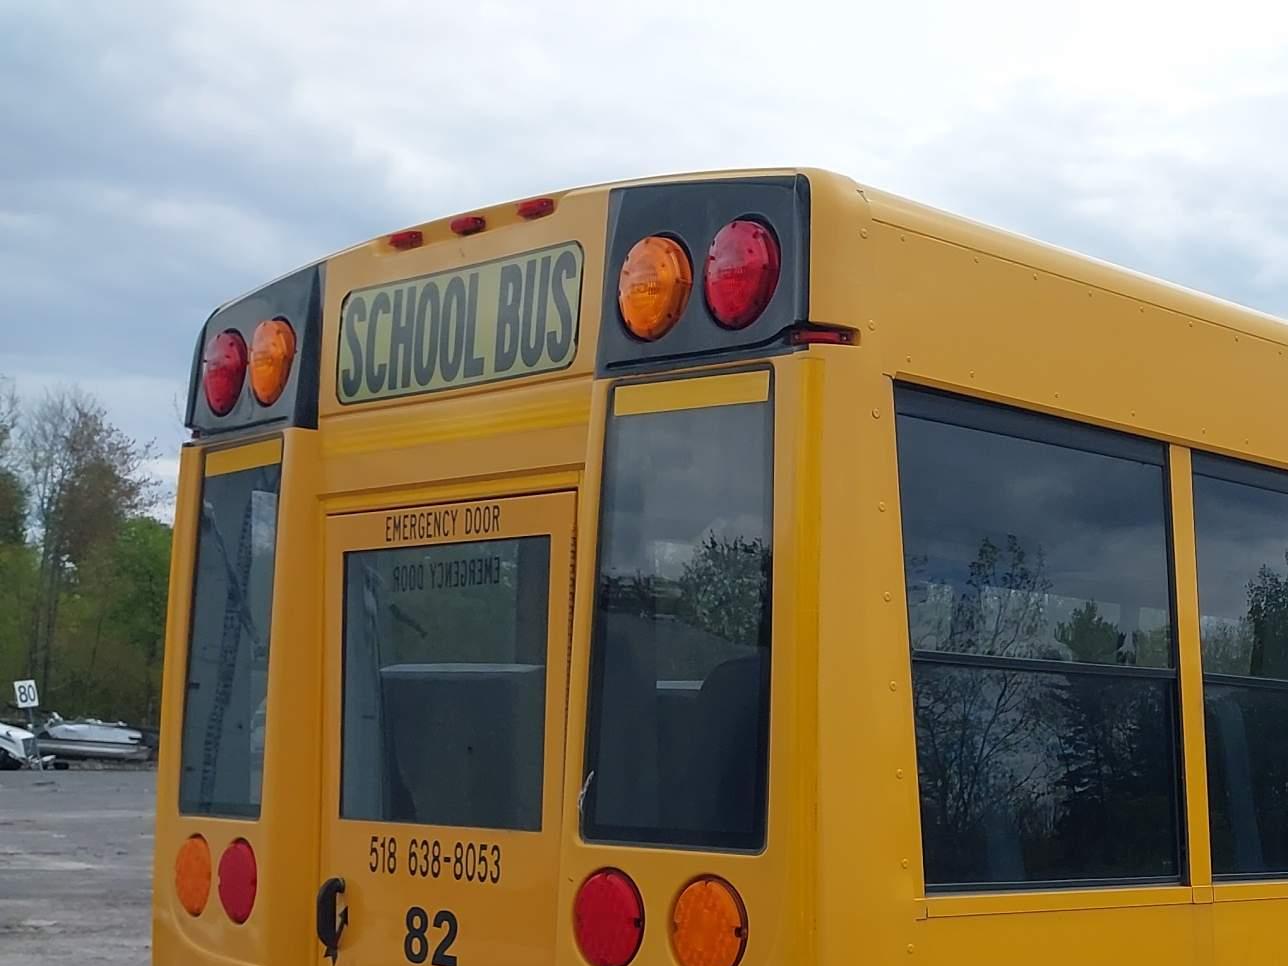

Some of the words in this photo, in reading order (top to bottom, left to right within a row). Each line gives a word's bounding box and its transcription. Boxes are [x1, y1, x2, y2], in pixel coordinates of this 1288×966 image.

[342, 272, 485, 398] SCHOOL
[494, 250, 577, 373] BUS
[385, 509, 459, 542] EMERGENCY
[464, 504, 501, 535] DOOR
[17, 684, 36, 704] 80
[369, 836, 397, 874] 518
[408, 838, 501, 884] 638-8053
